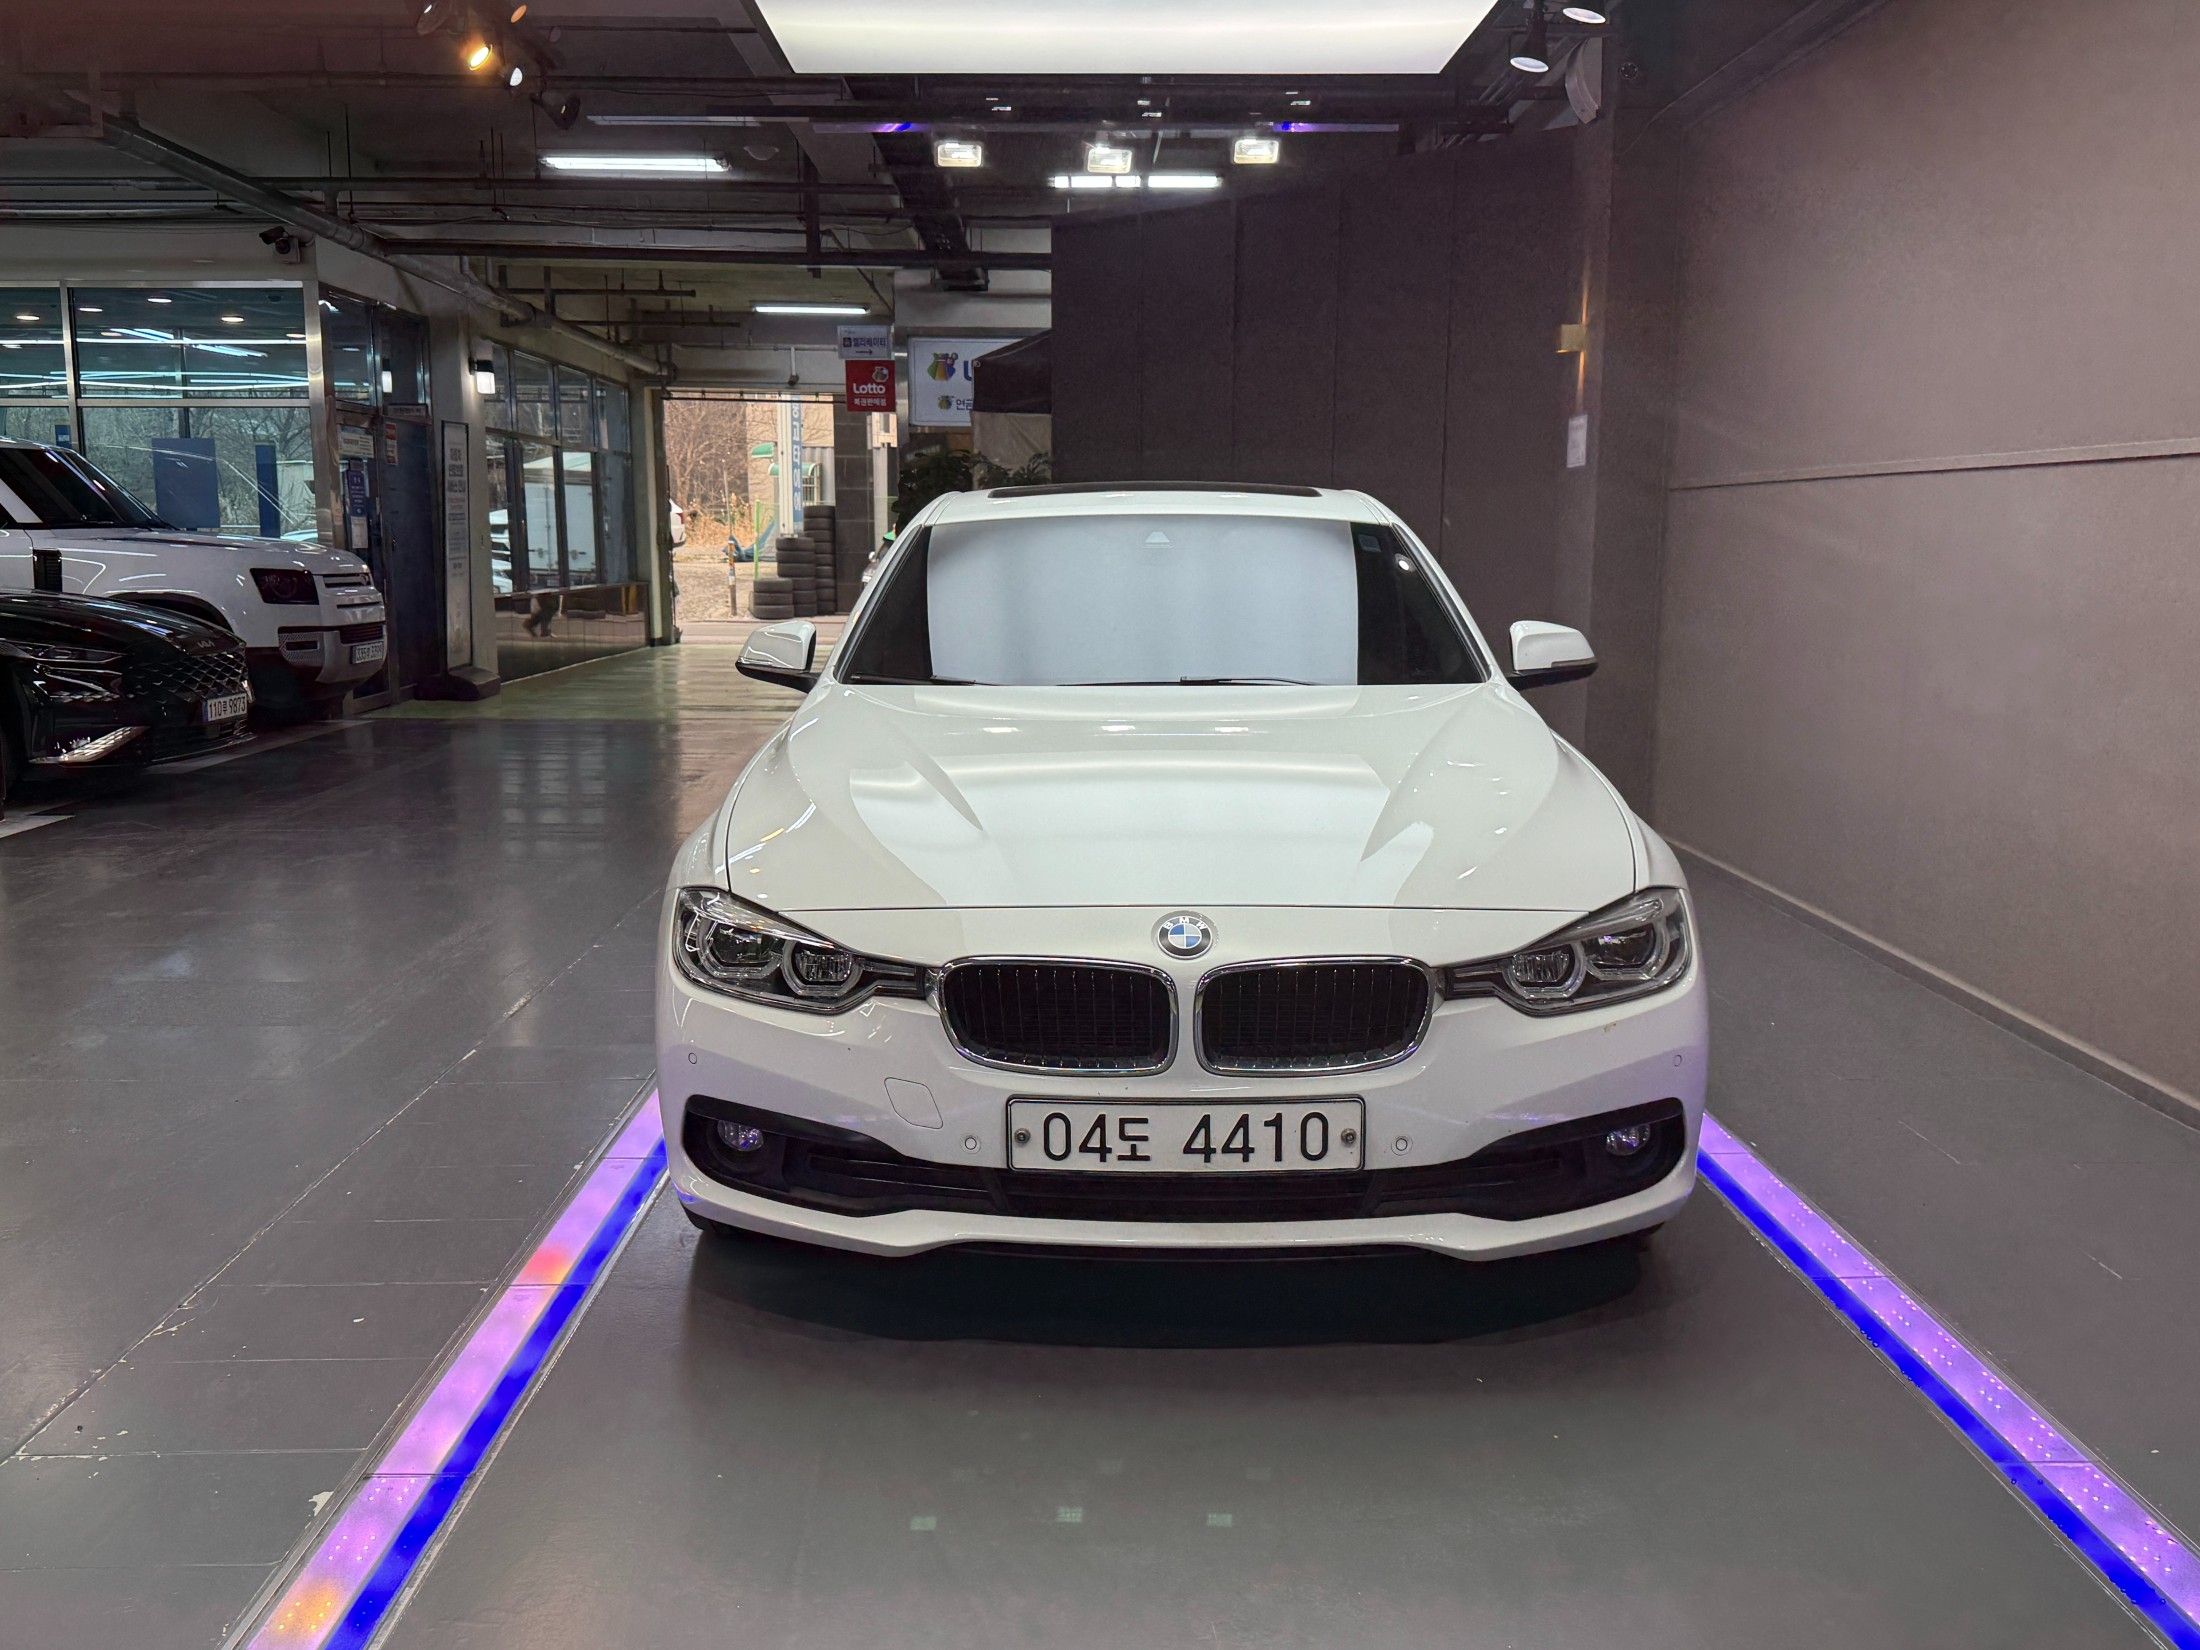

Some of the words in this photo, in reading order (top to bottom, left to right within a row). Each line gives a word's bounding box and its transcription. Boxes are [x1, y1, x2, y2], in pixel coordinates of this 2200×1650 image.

[852, 382, 886, 394] Lotto
[854, 398, 887, 407] 복권판매점
[228, 696, 246, 714] 9873
[1162, 916, 1209, 931] BMW
[1042, 1110, 1151, 1163] 04도
[1182, 1111, 1330, 1163] 4410
